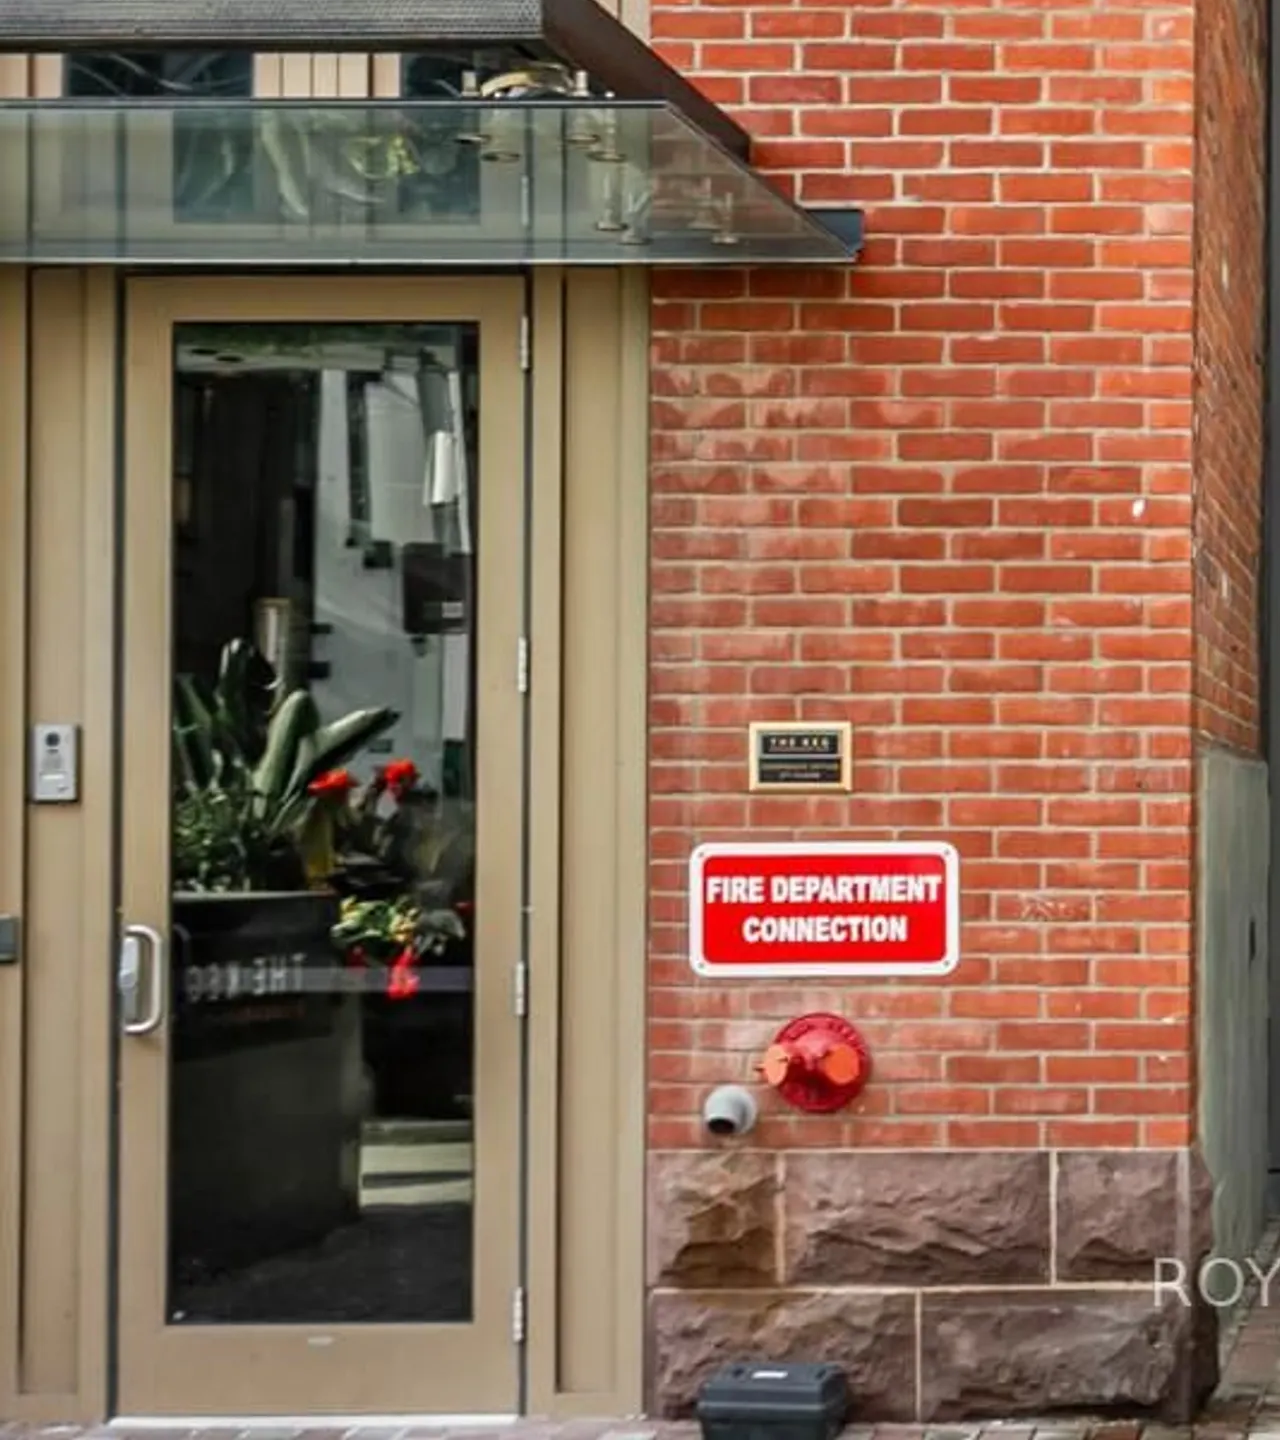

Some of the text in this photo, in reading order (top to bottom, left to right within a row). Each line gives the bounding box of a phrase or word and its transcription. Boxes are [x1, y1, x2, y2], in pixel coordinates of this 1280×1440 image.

[706, 874, 942, 903] FIRE DEPARTMENT
[742, 915, 908, 942] CONNECTION
